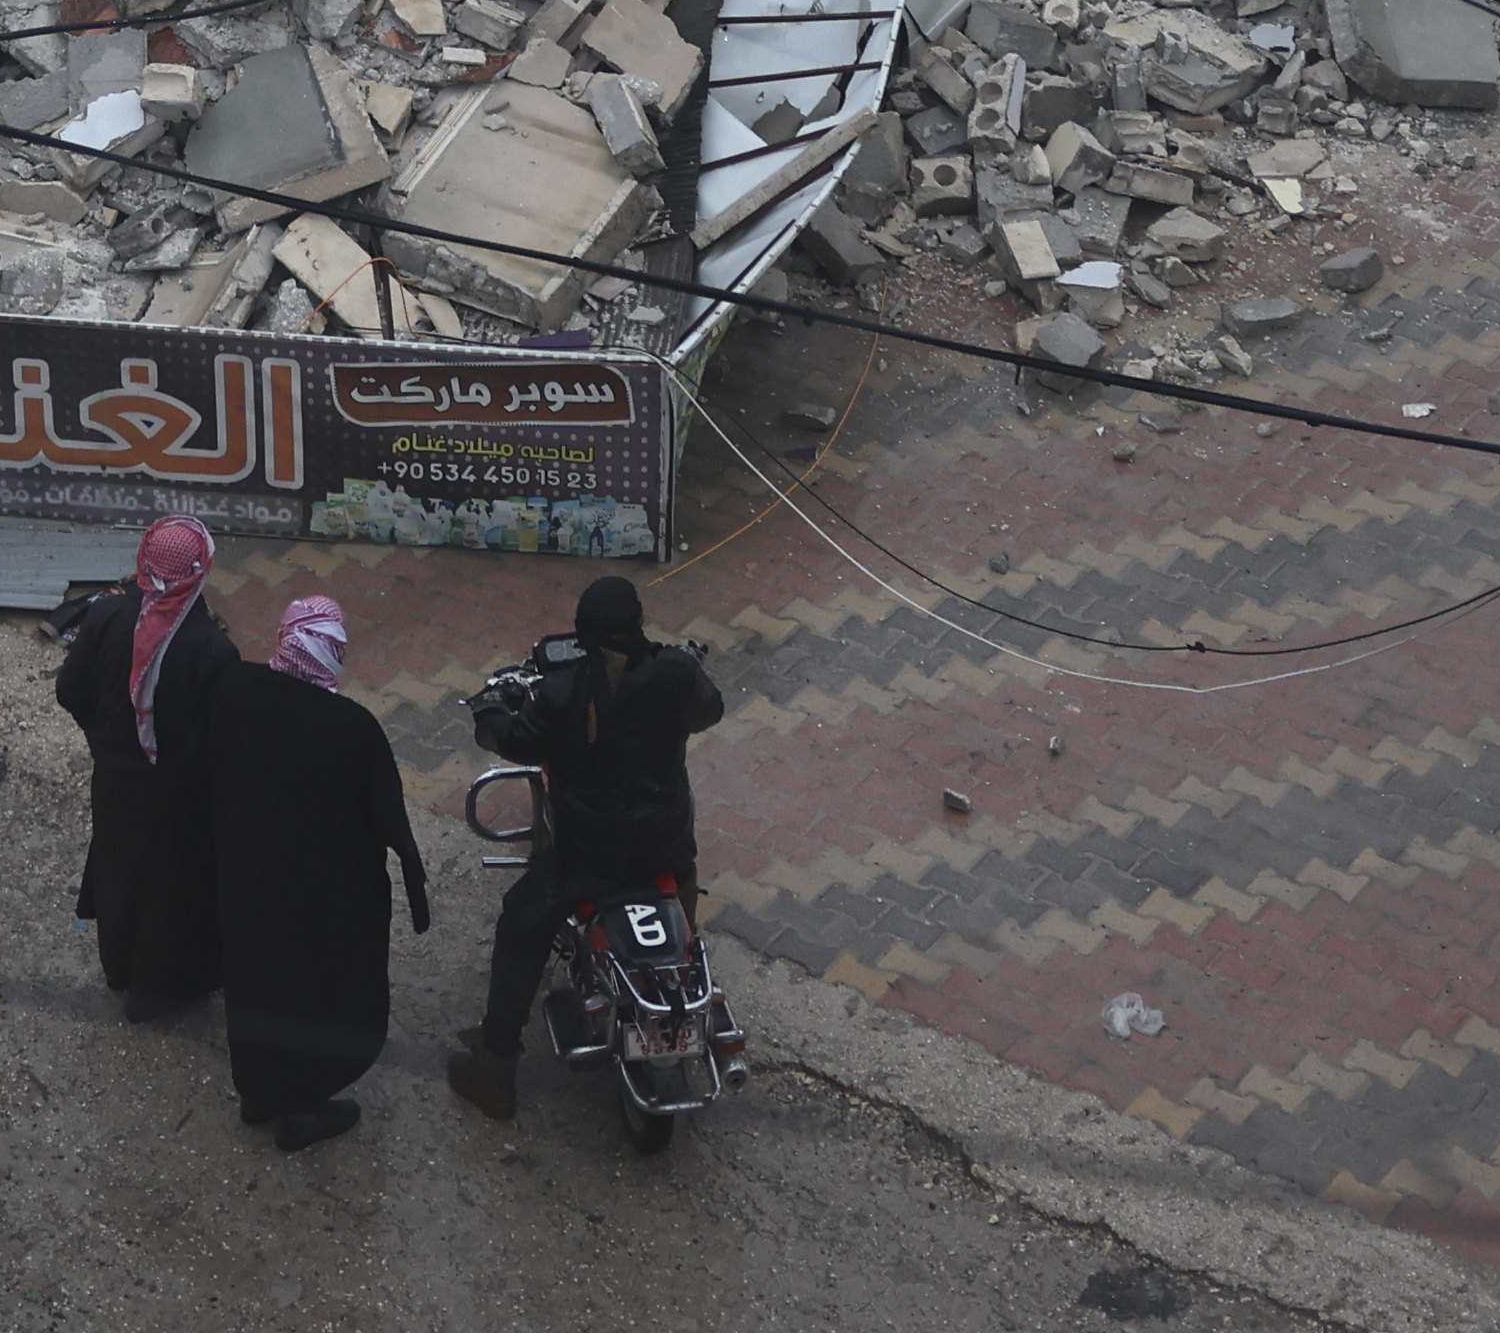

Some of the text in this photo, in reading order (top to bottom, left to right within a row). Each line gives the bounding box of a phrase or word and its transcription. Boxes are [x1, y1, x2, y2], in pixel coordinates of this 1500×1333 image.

[350, 376, 616, 413] سوبر ماركت
[392, 432, 595, 464] لصاحبه ميلاد غنام
[377, 459, 598, 490] +90 534 450 15 23
[45, 484, 140, 512] منظفات
[235, 499, 293, 524] مواد
[624, 903, 669, 948] AD
